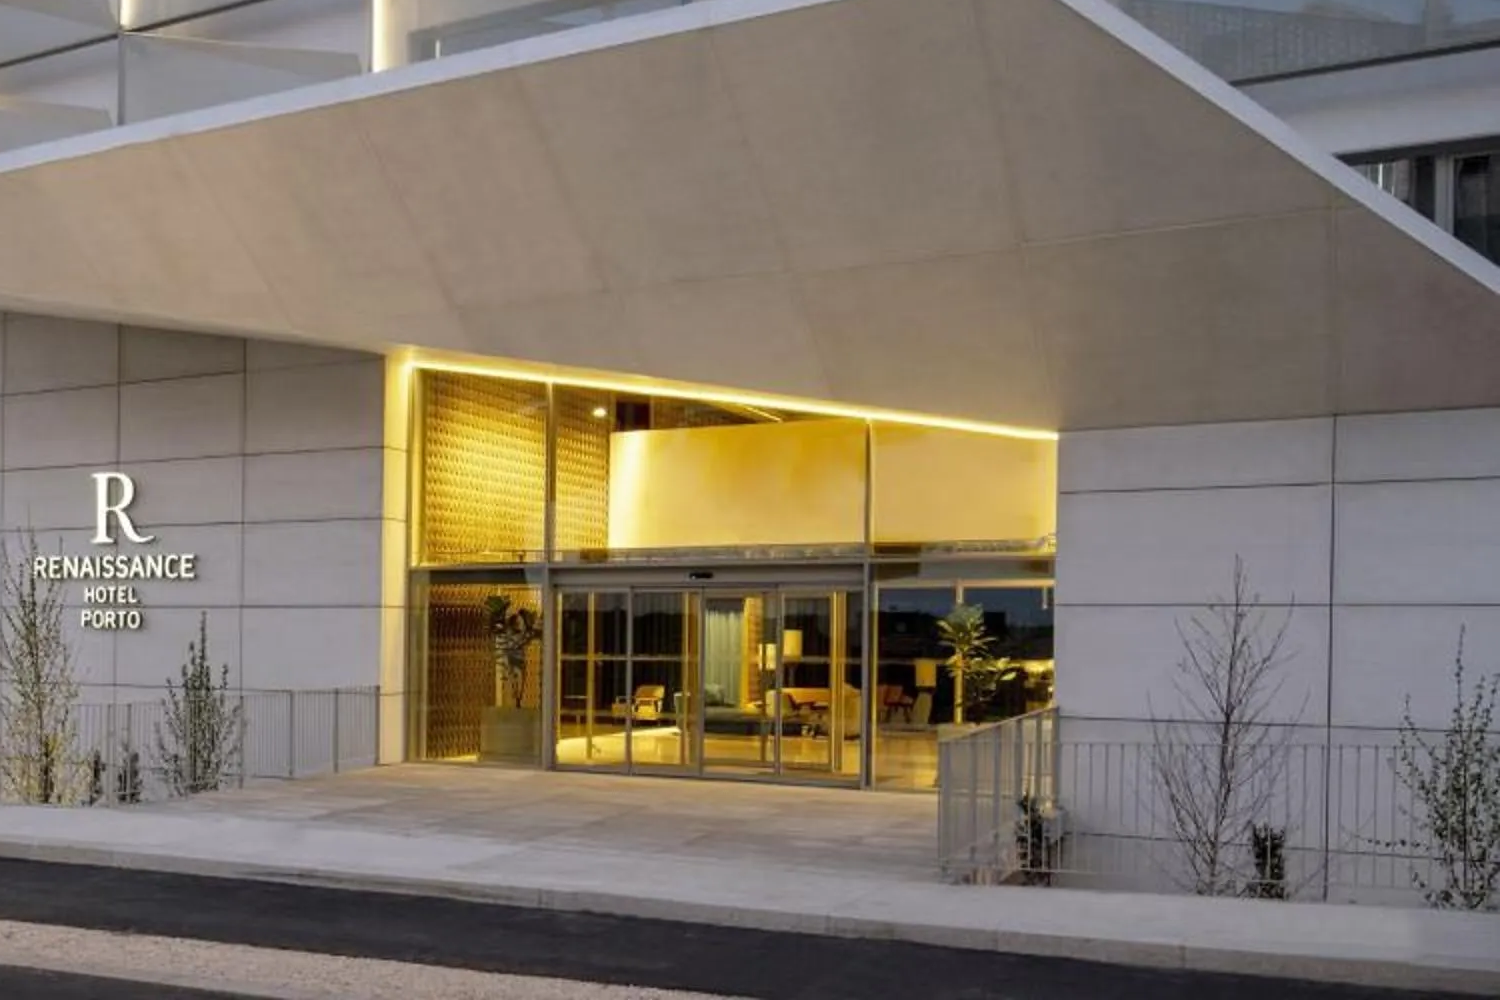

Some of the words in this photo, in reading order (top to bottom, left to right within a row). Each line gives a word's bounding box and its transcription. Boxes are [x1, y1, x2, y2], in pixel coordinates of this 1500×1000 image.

[90, 471, 155, 544] R
[33, 553, 195, 579] RENAISSANCE
[84, 586, 137, 603] HOTEL
[80, 609, 141, 629] PORTO
